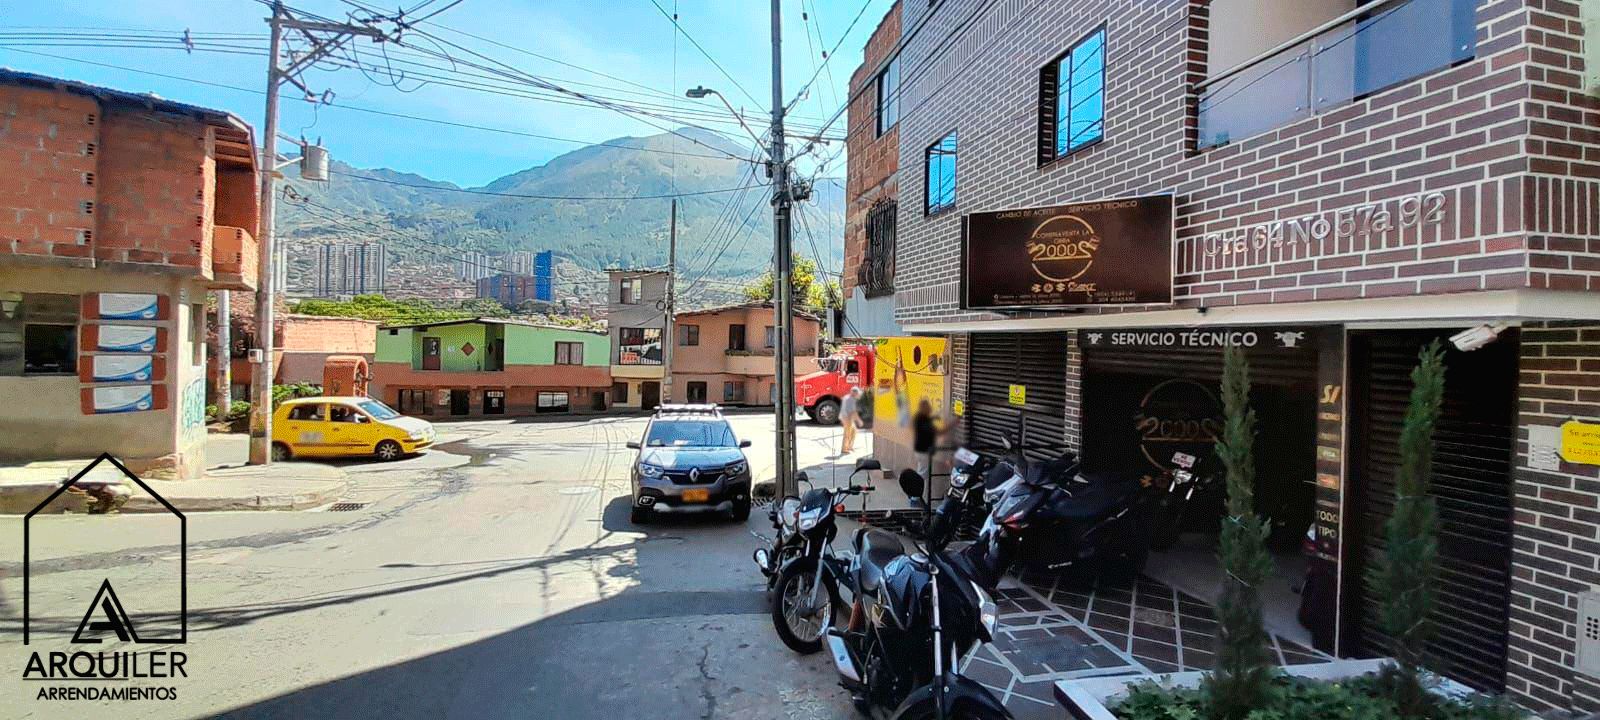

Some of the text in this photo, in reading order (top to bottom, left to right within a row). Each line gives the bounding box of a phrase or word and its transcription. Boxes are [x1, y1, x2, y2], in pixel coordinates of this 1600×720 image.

[996, 211, 1022, 220] CAMBIO
[1032, 208, 1057, 217] ACEITE
[1068, 204, 1102, 214] SERVICIO
[1204, 231, 1249, 257] Cra
[1252, 220, 1285, 251] 64
[1399, 190, 1448, 228] 92
[1111, 328, 1258, 347] SERVICIO TÉCNICO
